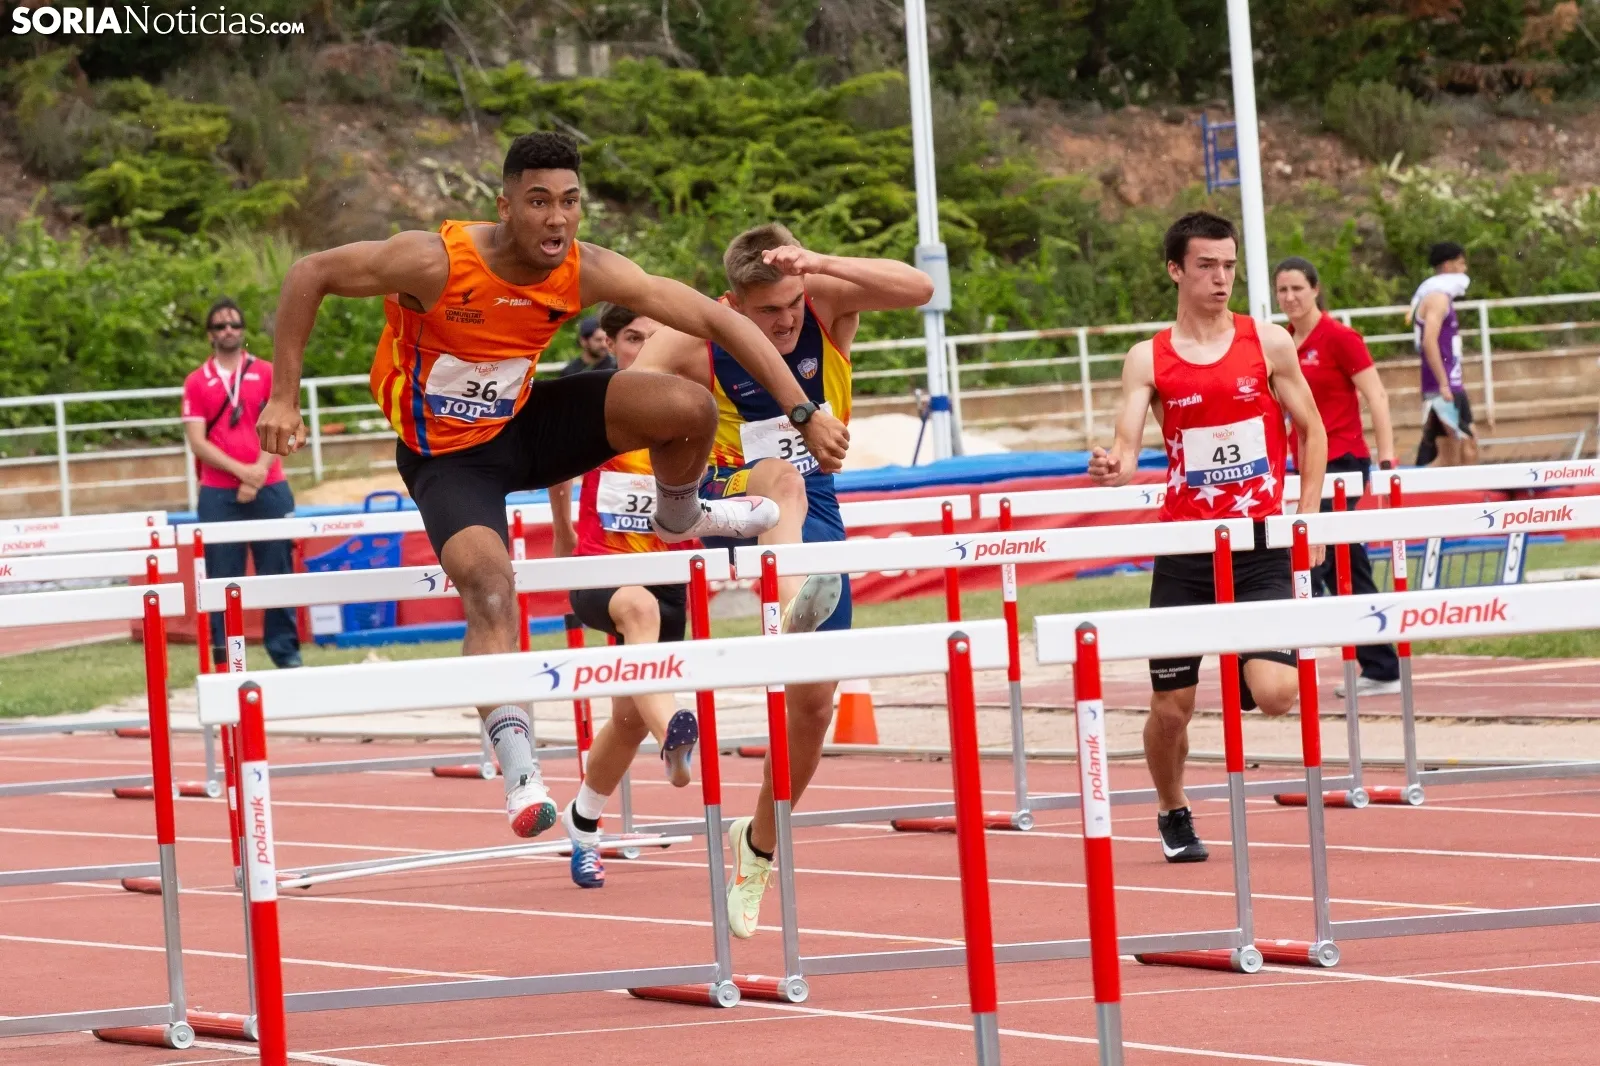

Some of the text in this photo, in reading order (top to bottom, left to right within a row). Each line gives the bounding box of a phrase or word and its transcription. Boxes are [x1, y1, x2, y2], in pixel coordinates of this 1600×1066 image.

[461, 380, 498, 403] 36
[778, 435, 809, 460] 33
[1212, 444, 1241, 465] 43
[1543, 465, 1596, 483] polanik
[625, 494, 653, 514] 32
[611, 516, 649, 529] Jom
[1502, 504, 1574, 529] polanik
[3, 539, 46, 551] polanik
[975, 537, 1047, 561] polanik
[1400, 597, 1509, 633] polanik
[573, 653, 685, 691] polanik
[1085, 734, 1106, 802] polanik
[251, 796, 271, 864] polanik
